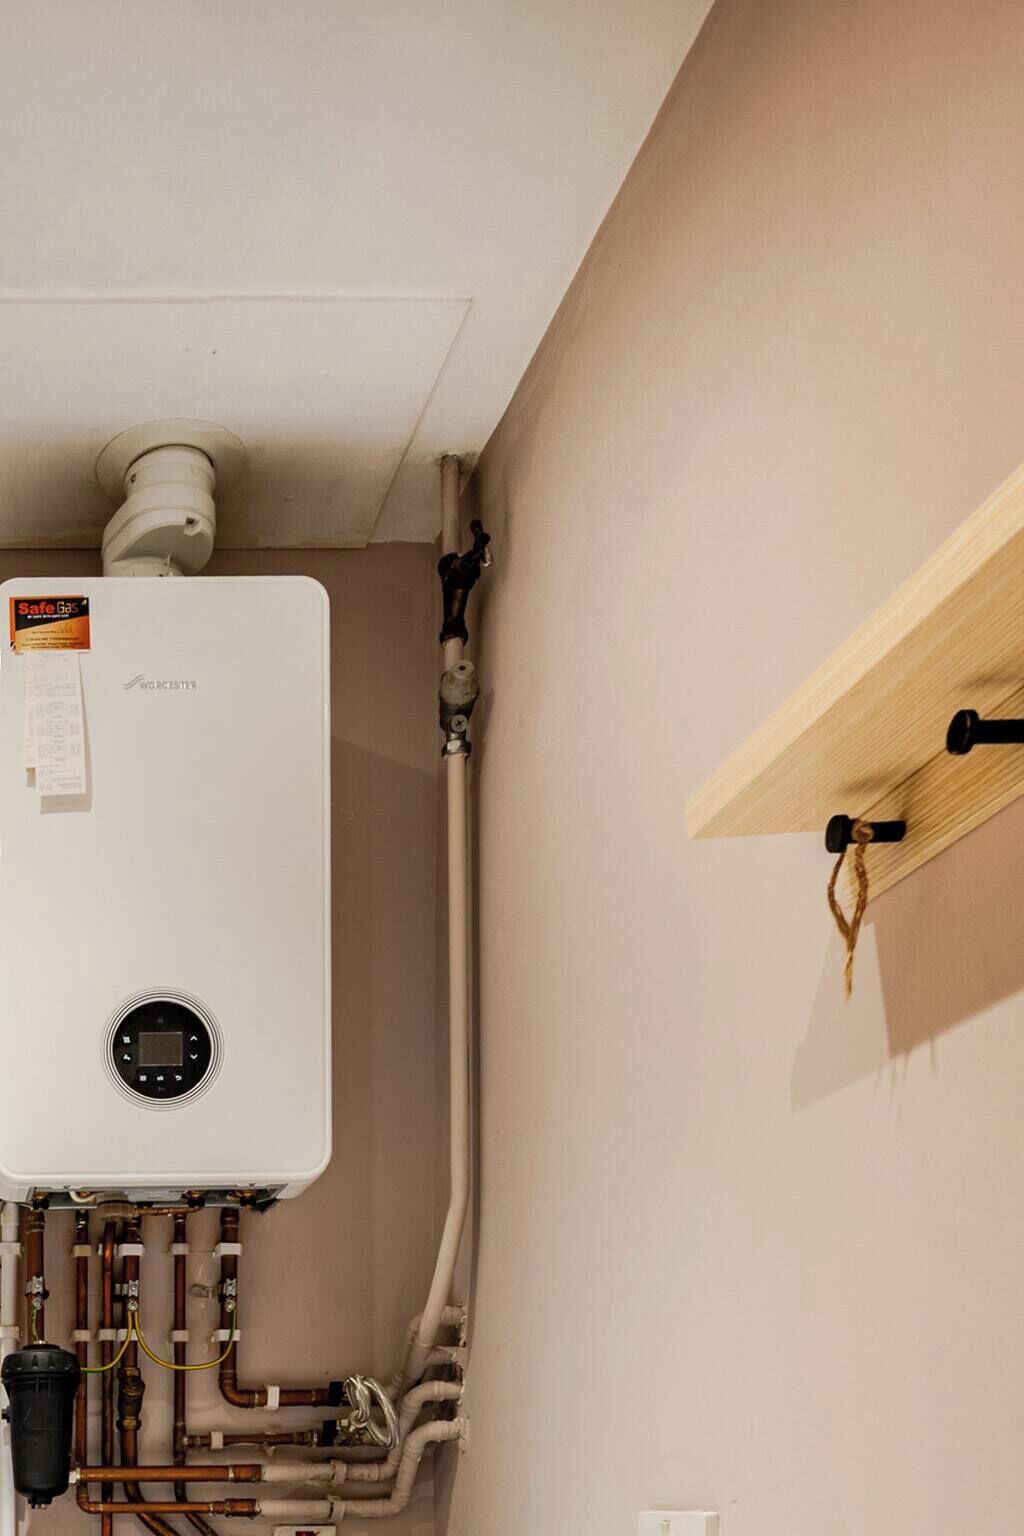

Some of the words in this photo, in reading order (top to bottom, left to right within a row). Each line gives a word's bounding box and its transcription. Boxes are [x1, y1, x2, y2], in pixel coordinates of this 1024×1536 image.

[18, 601, 54, 615] Safe
[56, 600, 79, 614] Gas
[140, 681, 197, 690] WORCESTER
